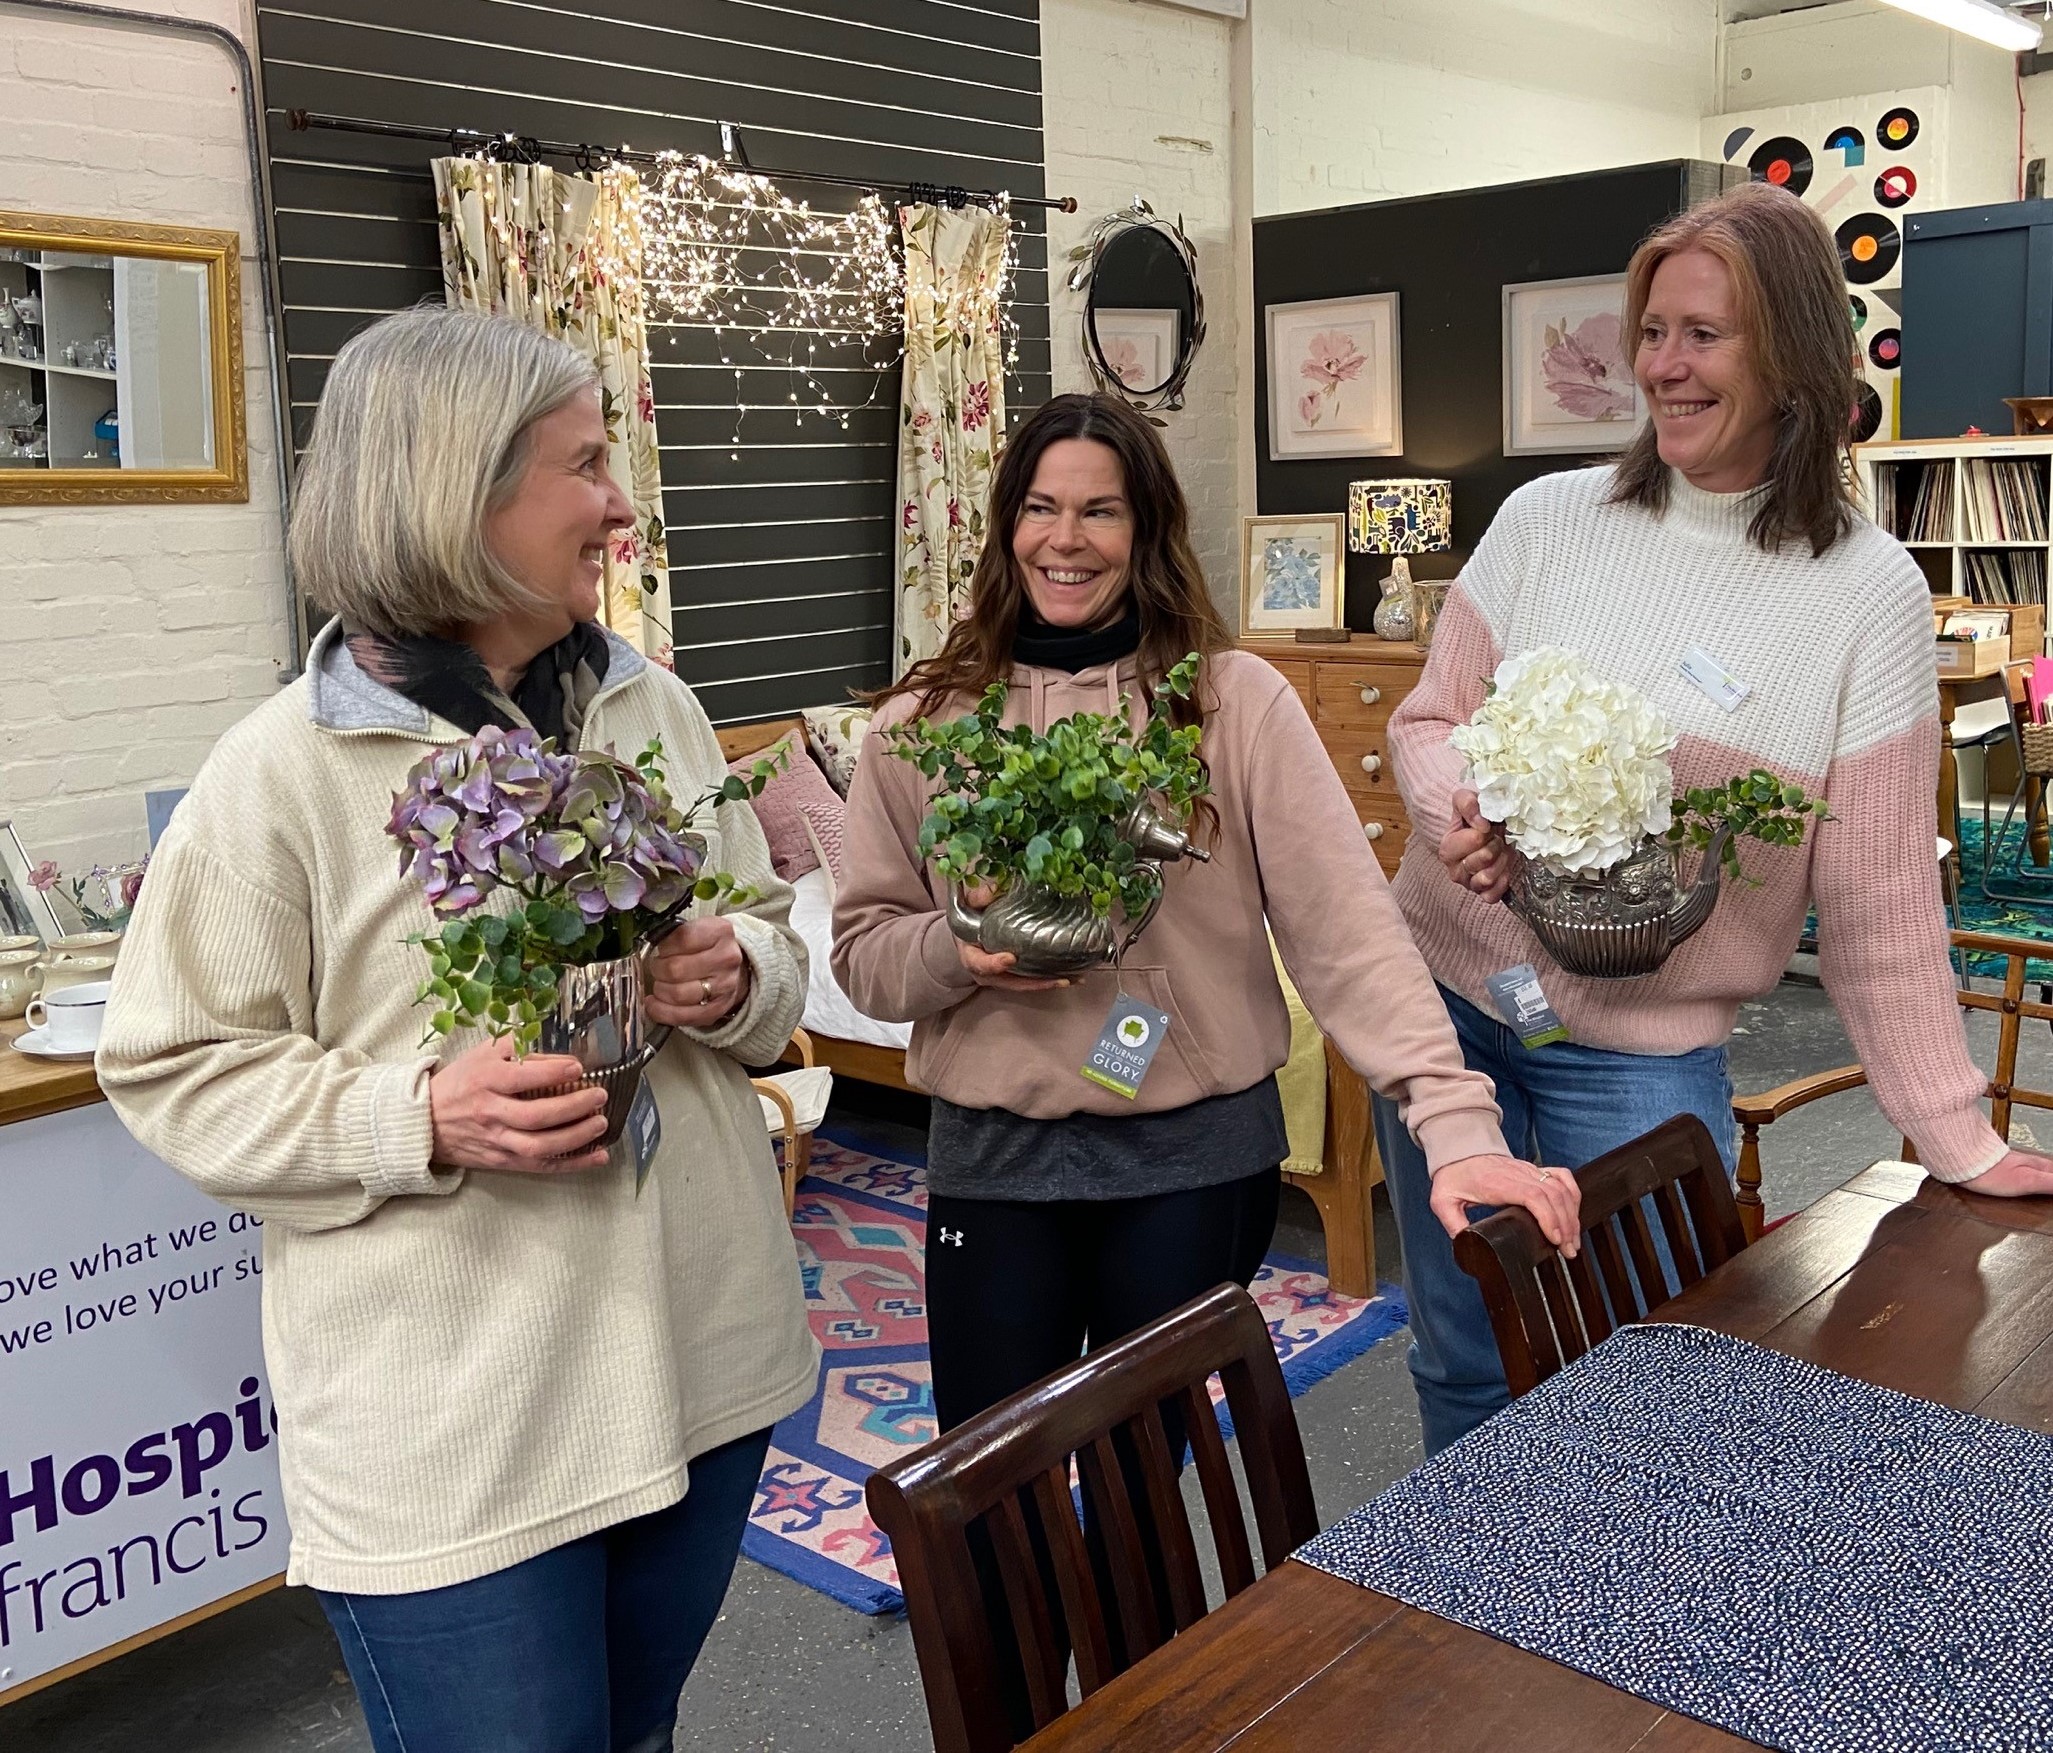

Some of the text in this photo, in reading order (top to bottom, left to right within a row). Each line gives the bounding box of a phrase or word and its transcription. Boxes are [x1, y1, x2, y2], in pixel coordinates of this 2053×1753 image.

[1093, 1053, 1140, 1080] GLORY
[1100, 1039, 1145, 1066] RETURNED
[69, 1233, 158, 1280] what
[168, 1220, 217, 1251] we
[0, 1320, 53, 1354] we
[65, 1293, 137, 1335] love
[148, 1265, 224, 1314] your
[0, 1376, 278, 1546] Hospi
[0, 1488, 268, 1647] francis
